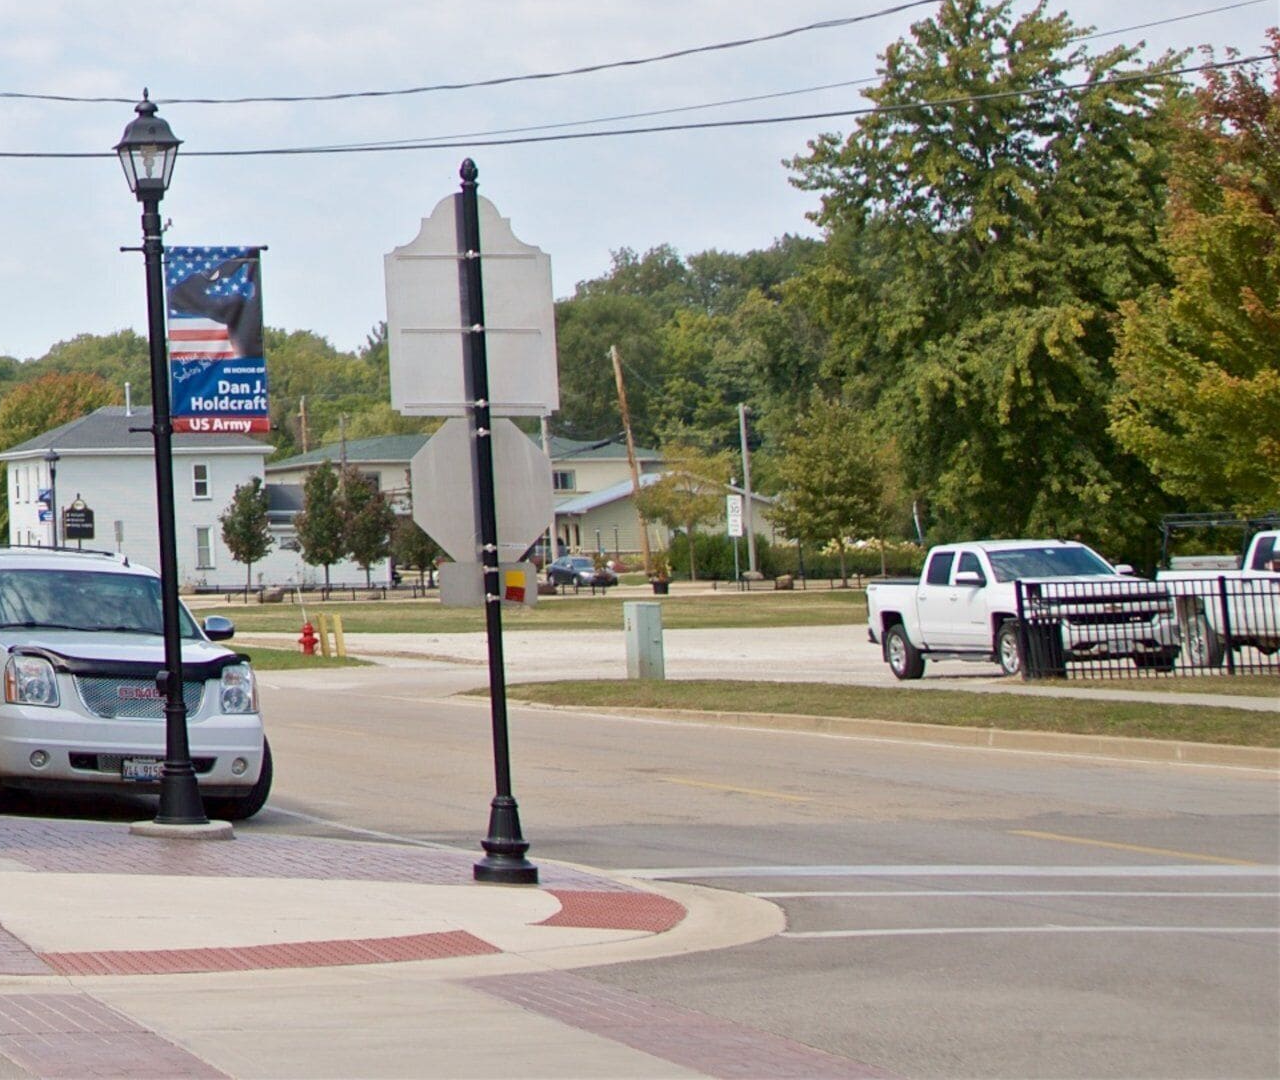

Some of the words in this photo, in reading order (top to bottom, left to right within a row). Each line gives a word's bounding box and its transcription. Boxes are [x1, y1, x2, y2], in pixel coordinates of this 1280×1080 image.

[218, 380, 250, 394] Dan
[253, 380, 266, 394] J.
[191, 396, 267, 411] Holdcraft
[189, 418, 210, 431] US
[212, 418, 252, 432] Army
